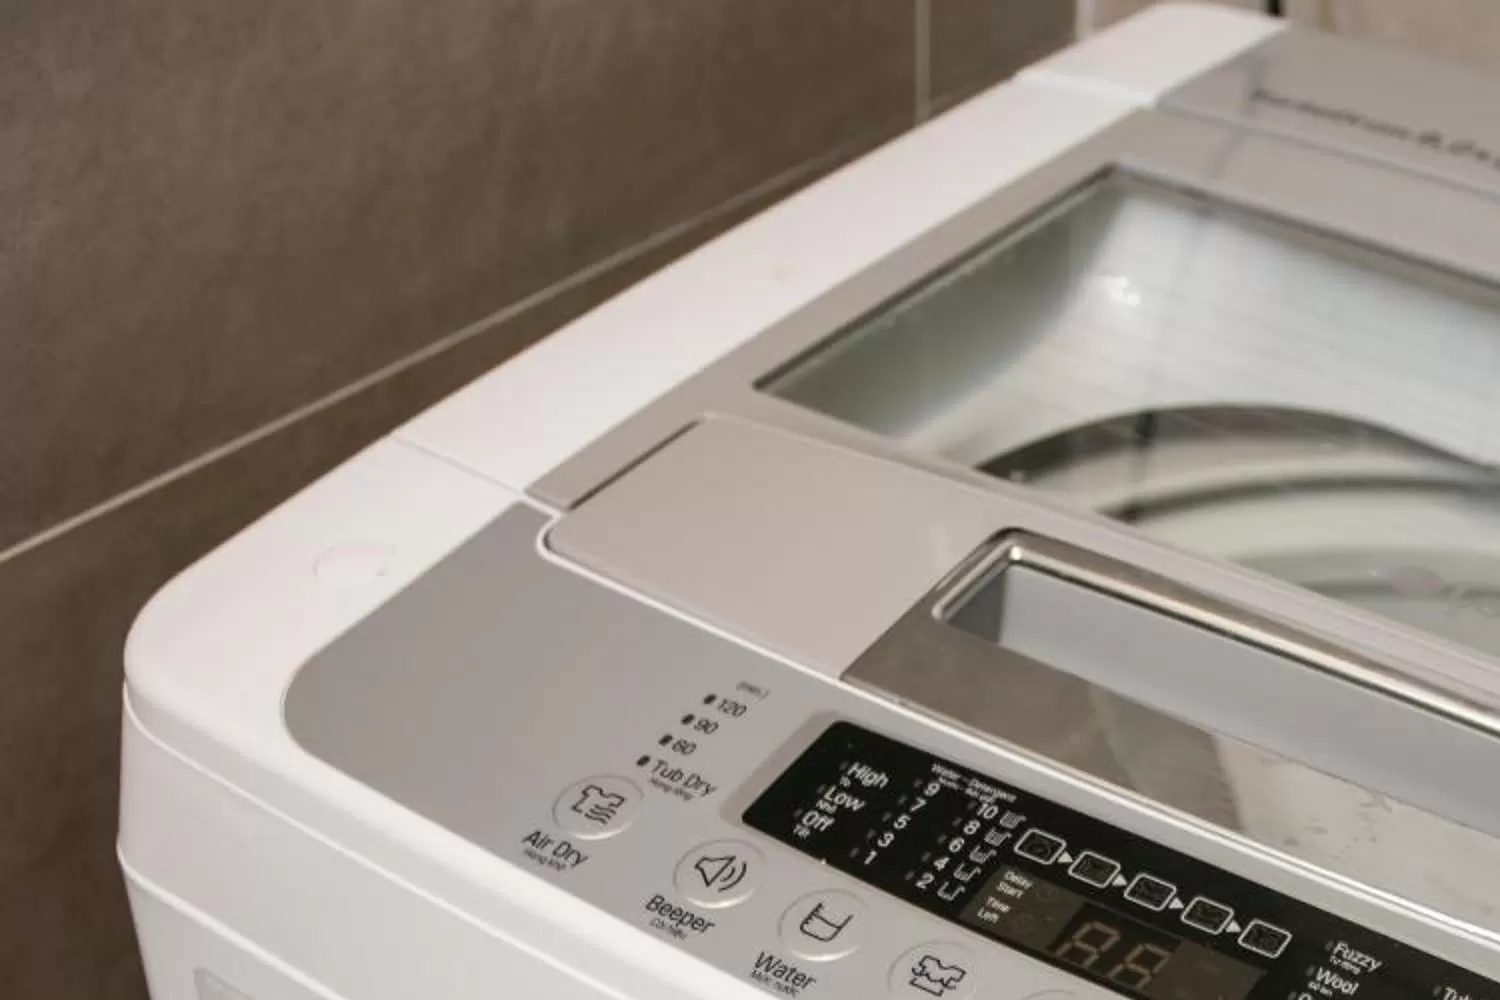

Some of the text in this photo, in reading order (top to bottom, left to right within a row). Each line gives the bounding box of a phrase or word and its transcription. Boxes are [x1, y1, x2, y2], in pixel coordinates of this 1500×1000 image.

[652, 759, 684, 783] Tub
[683, 773, 718, 797] Dry
[847, 761, 890, 789] High
[925, 781, 941, 798] 9
[823, 786, 866, 812] Low
[910, 797, 927, 813] 7
[976, 802, 1000, 820] 10
[801, 811, 834, 834] Off
[893, 814, 911, 830] 5
[963, 819, 981, 835] 8
[521, 829, 554, 850] Air
[552, 841, 589, 868] Dry
[877, 832, 895, 848] 3
[949, 837, 965, 853] 6
[864, 850, 877, 866] 1
[933, 855, 950, 871] 4
[915, 872, 935, 890] 2
[645, 894, 716, 934] Beeper
[1333, 941, 1382, 972] Fuzzy
[753, 950, 817, 991] Water
[1315, 966, 1360, 996] Wool
